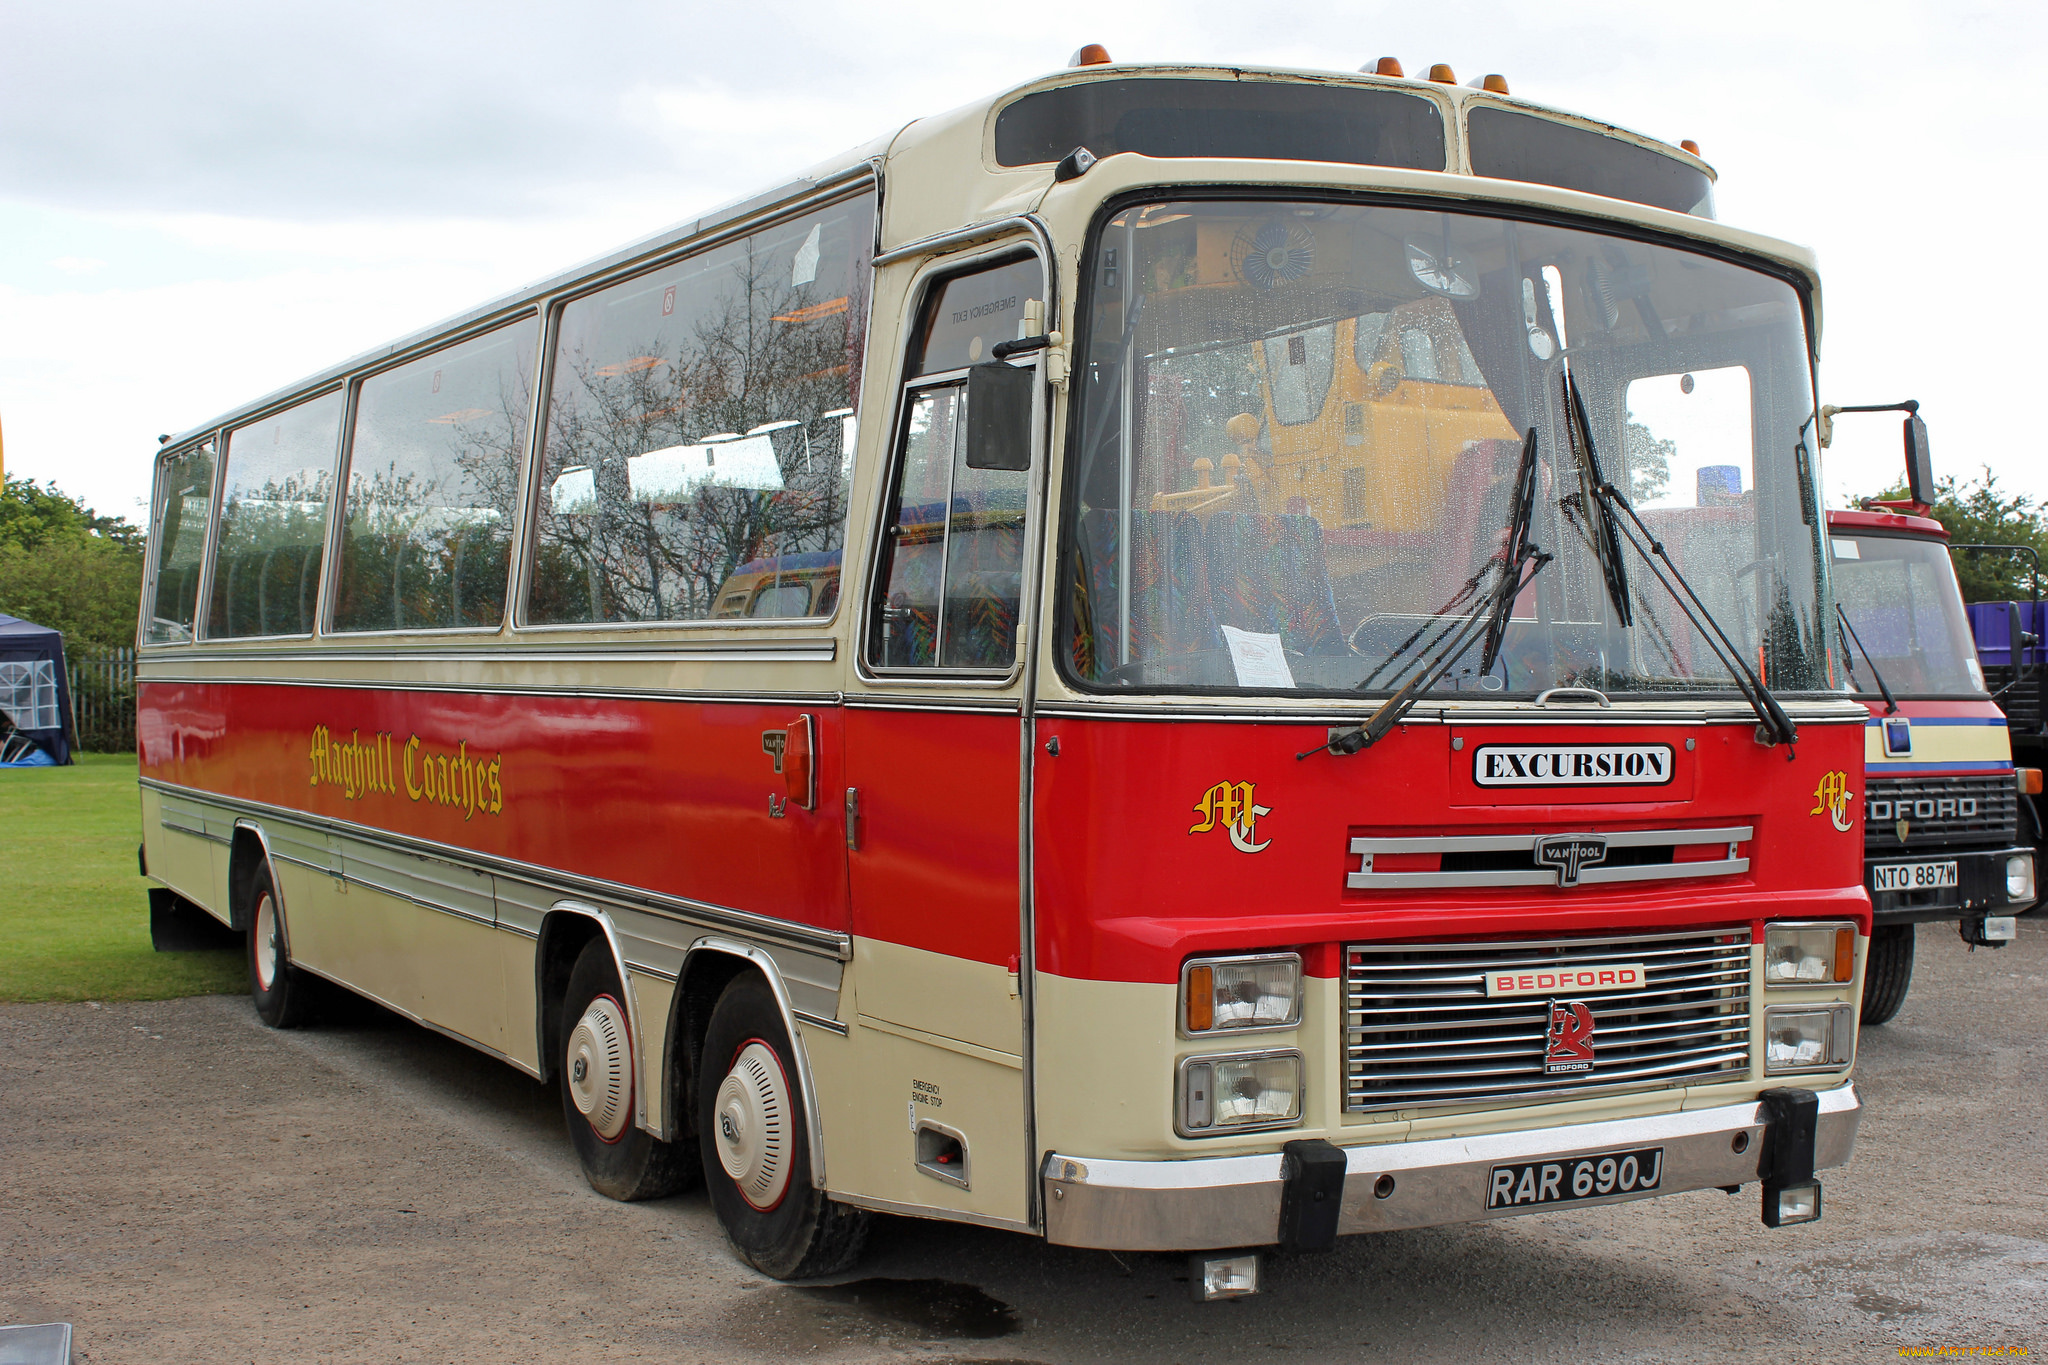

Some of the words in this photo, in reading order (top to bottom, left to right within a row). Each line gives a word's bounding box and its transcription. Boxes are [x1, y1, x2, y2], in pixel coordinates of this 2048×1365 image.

[309, 723, 397, 800] Maghull
[403, 731, 502, 822] Coaches
[1484, 752, 1664, 778] EXCURSION
[1864, 798, 1977, 820] DFORD
[1875, 867, 1909, 889] NTO
[1915, 864, 1956, 886] 887W
[1496, 969, 1636, 991] BEDFORD
[1550, 1063, 1589, 1072] BEDFORD
[912, 1079, 940, 1096] EMERGENCY
[912, 1091, 929, 1105] ENGINE
[930, 1096, 943, 1108] STOP
[1490, 1164, 1562, 1207] RAR
[1572, 1151, 1661, 1197] 690J
